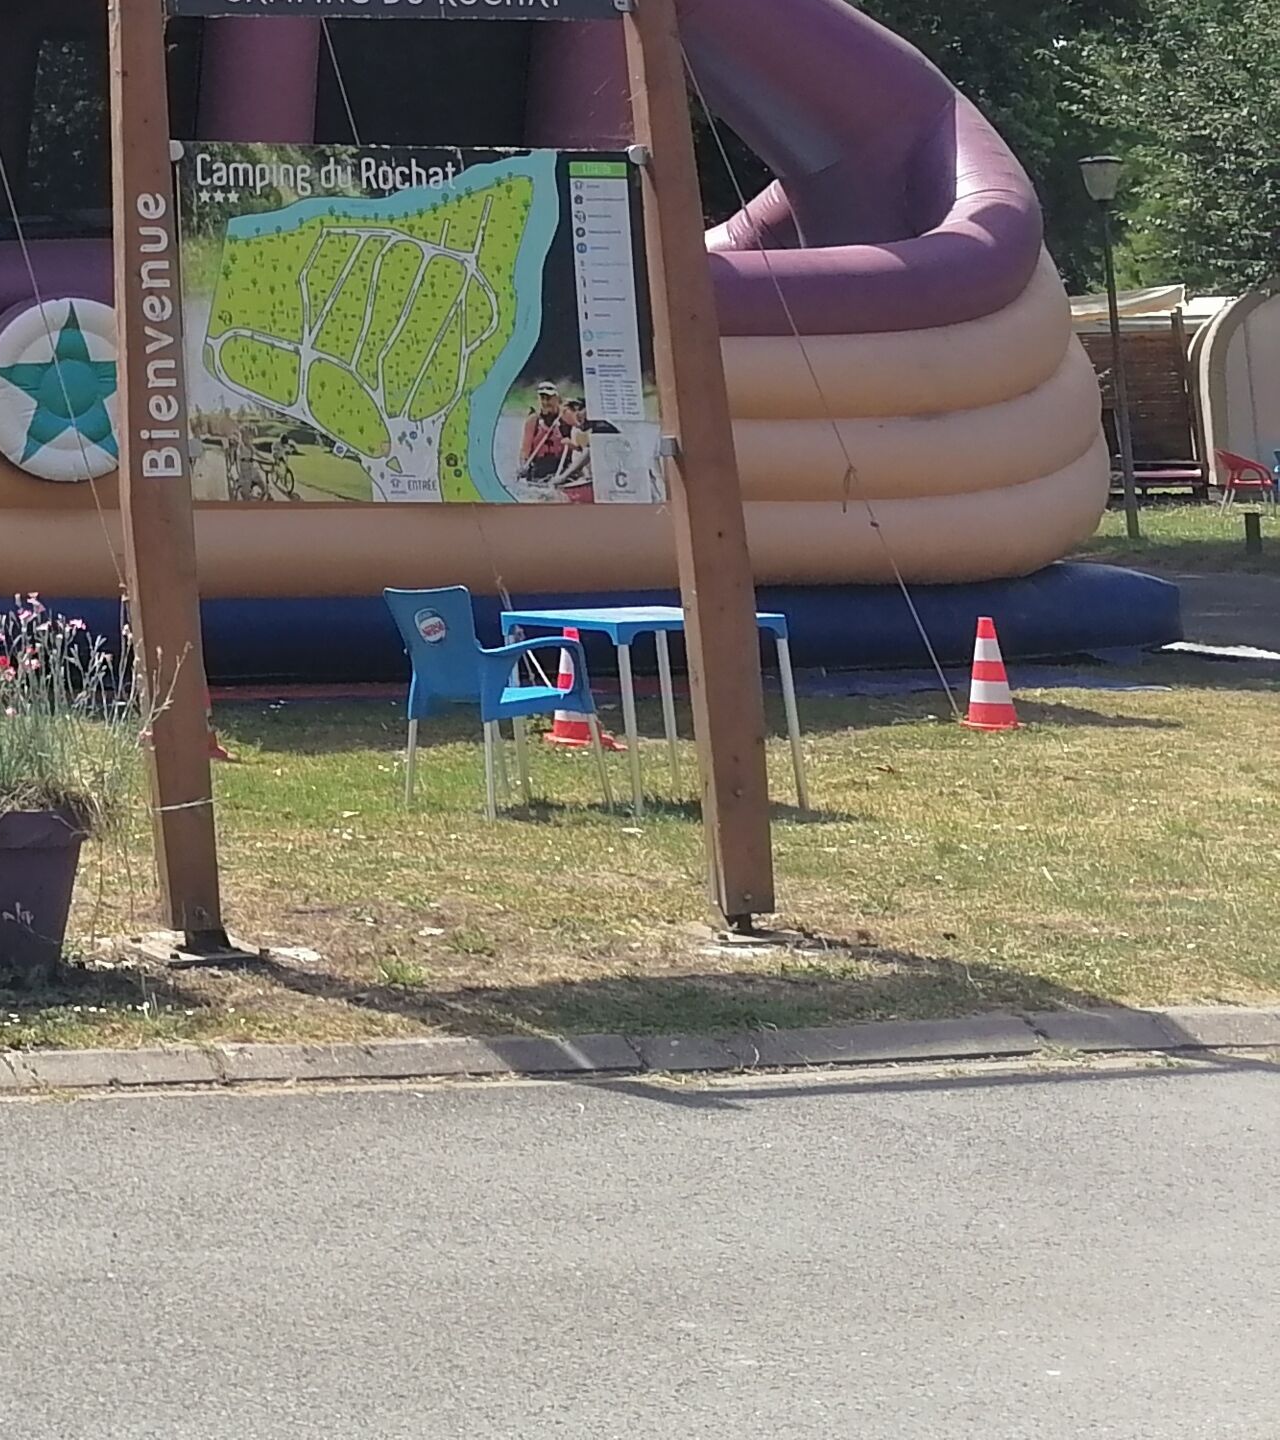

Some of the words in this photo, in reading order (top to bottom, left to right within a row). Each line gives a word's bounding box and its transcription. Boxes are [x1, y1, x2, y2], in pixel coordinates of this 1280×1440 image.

[196, 153, 311, 196] Camping
[320, 156, 352, 188] du
[360, 157, 456, 190] Rochat
[136, 192, 182, 477] Bienvenue
